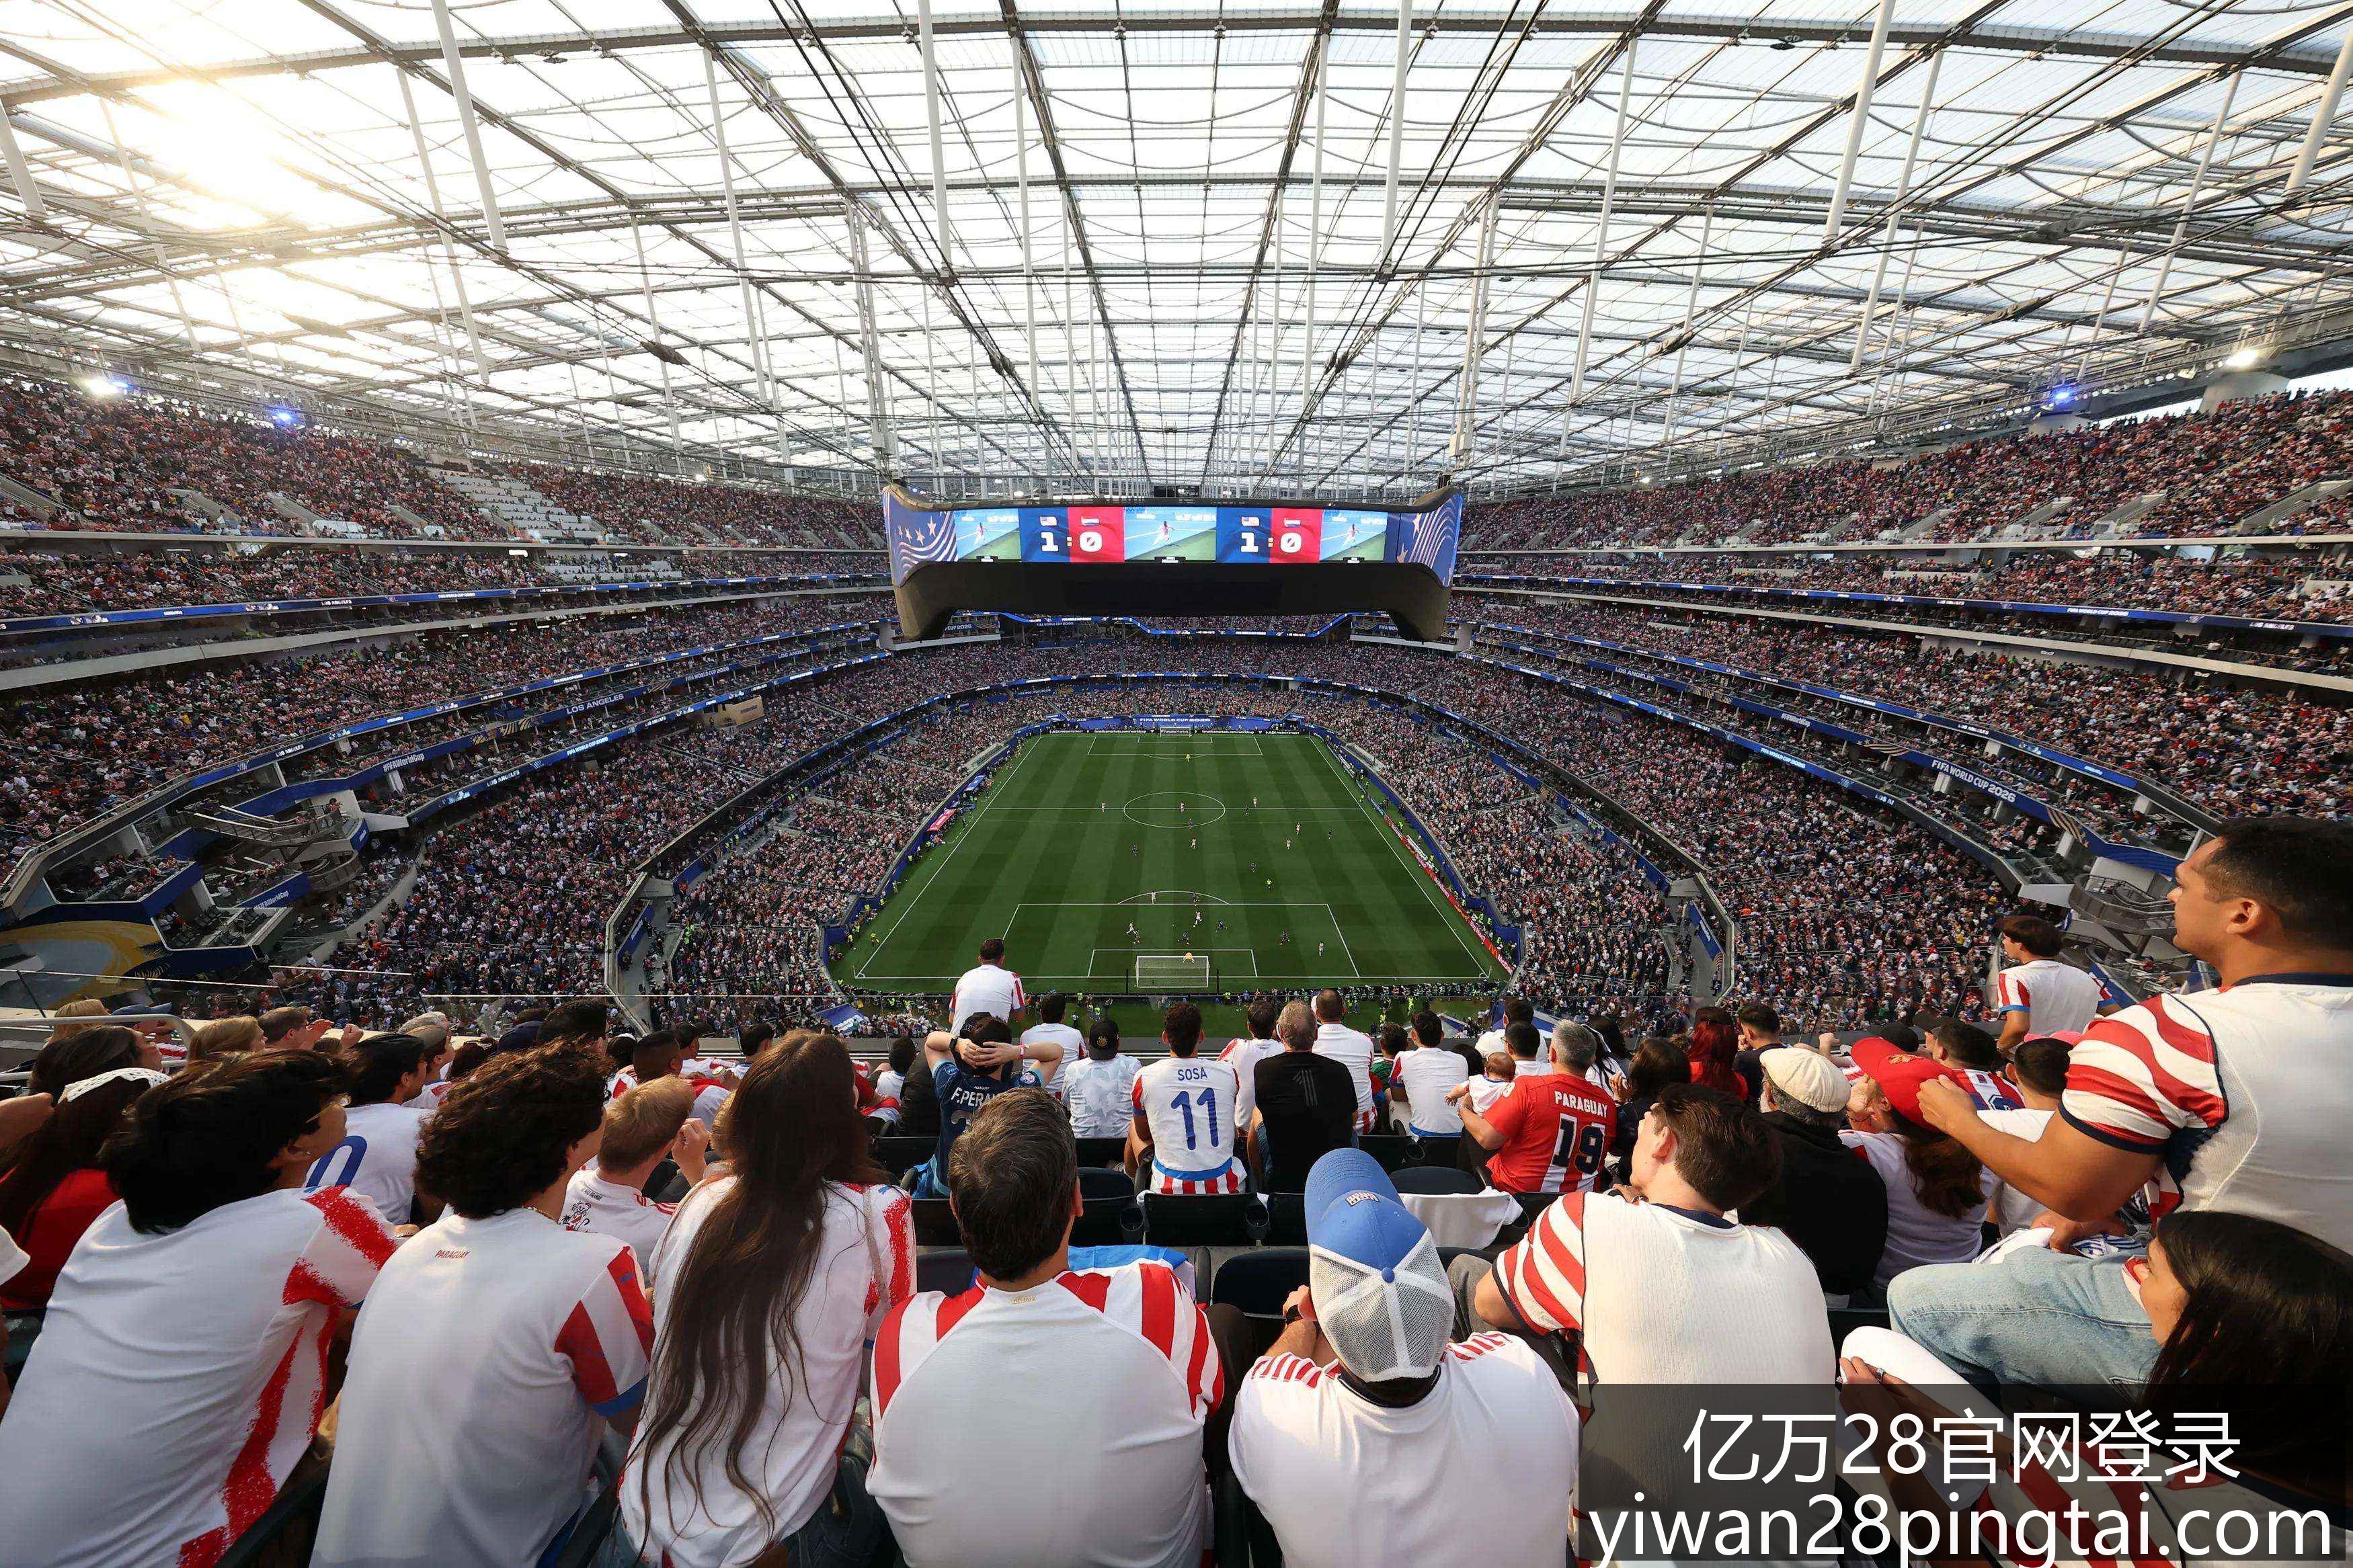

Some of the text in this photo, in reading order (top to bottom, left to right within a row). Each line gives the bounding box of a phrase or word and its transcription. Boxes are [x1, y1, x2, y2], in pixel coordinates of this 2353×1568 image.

[1627, 670, 1655, 682] ANGELES
[566, 693, 624, 714] LOS ANGELES
[383, 753, 425, 773] #FIFAWorldCup
[1931, 759, 2016, 803] FIFA WORLD CUP 2026
[1177, 1067, 1208, 1081] SOSA
[1554, 1090, 1609, 1118] PARAGUAY
[1170, 1087, 1219, 1151] 11
[1550, 1113, 1606, 1174] 19
[434, 1249, 471, 1259] PARAGUAY
